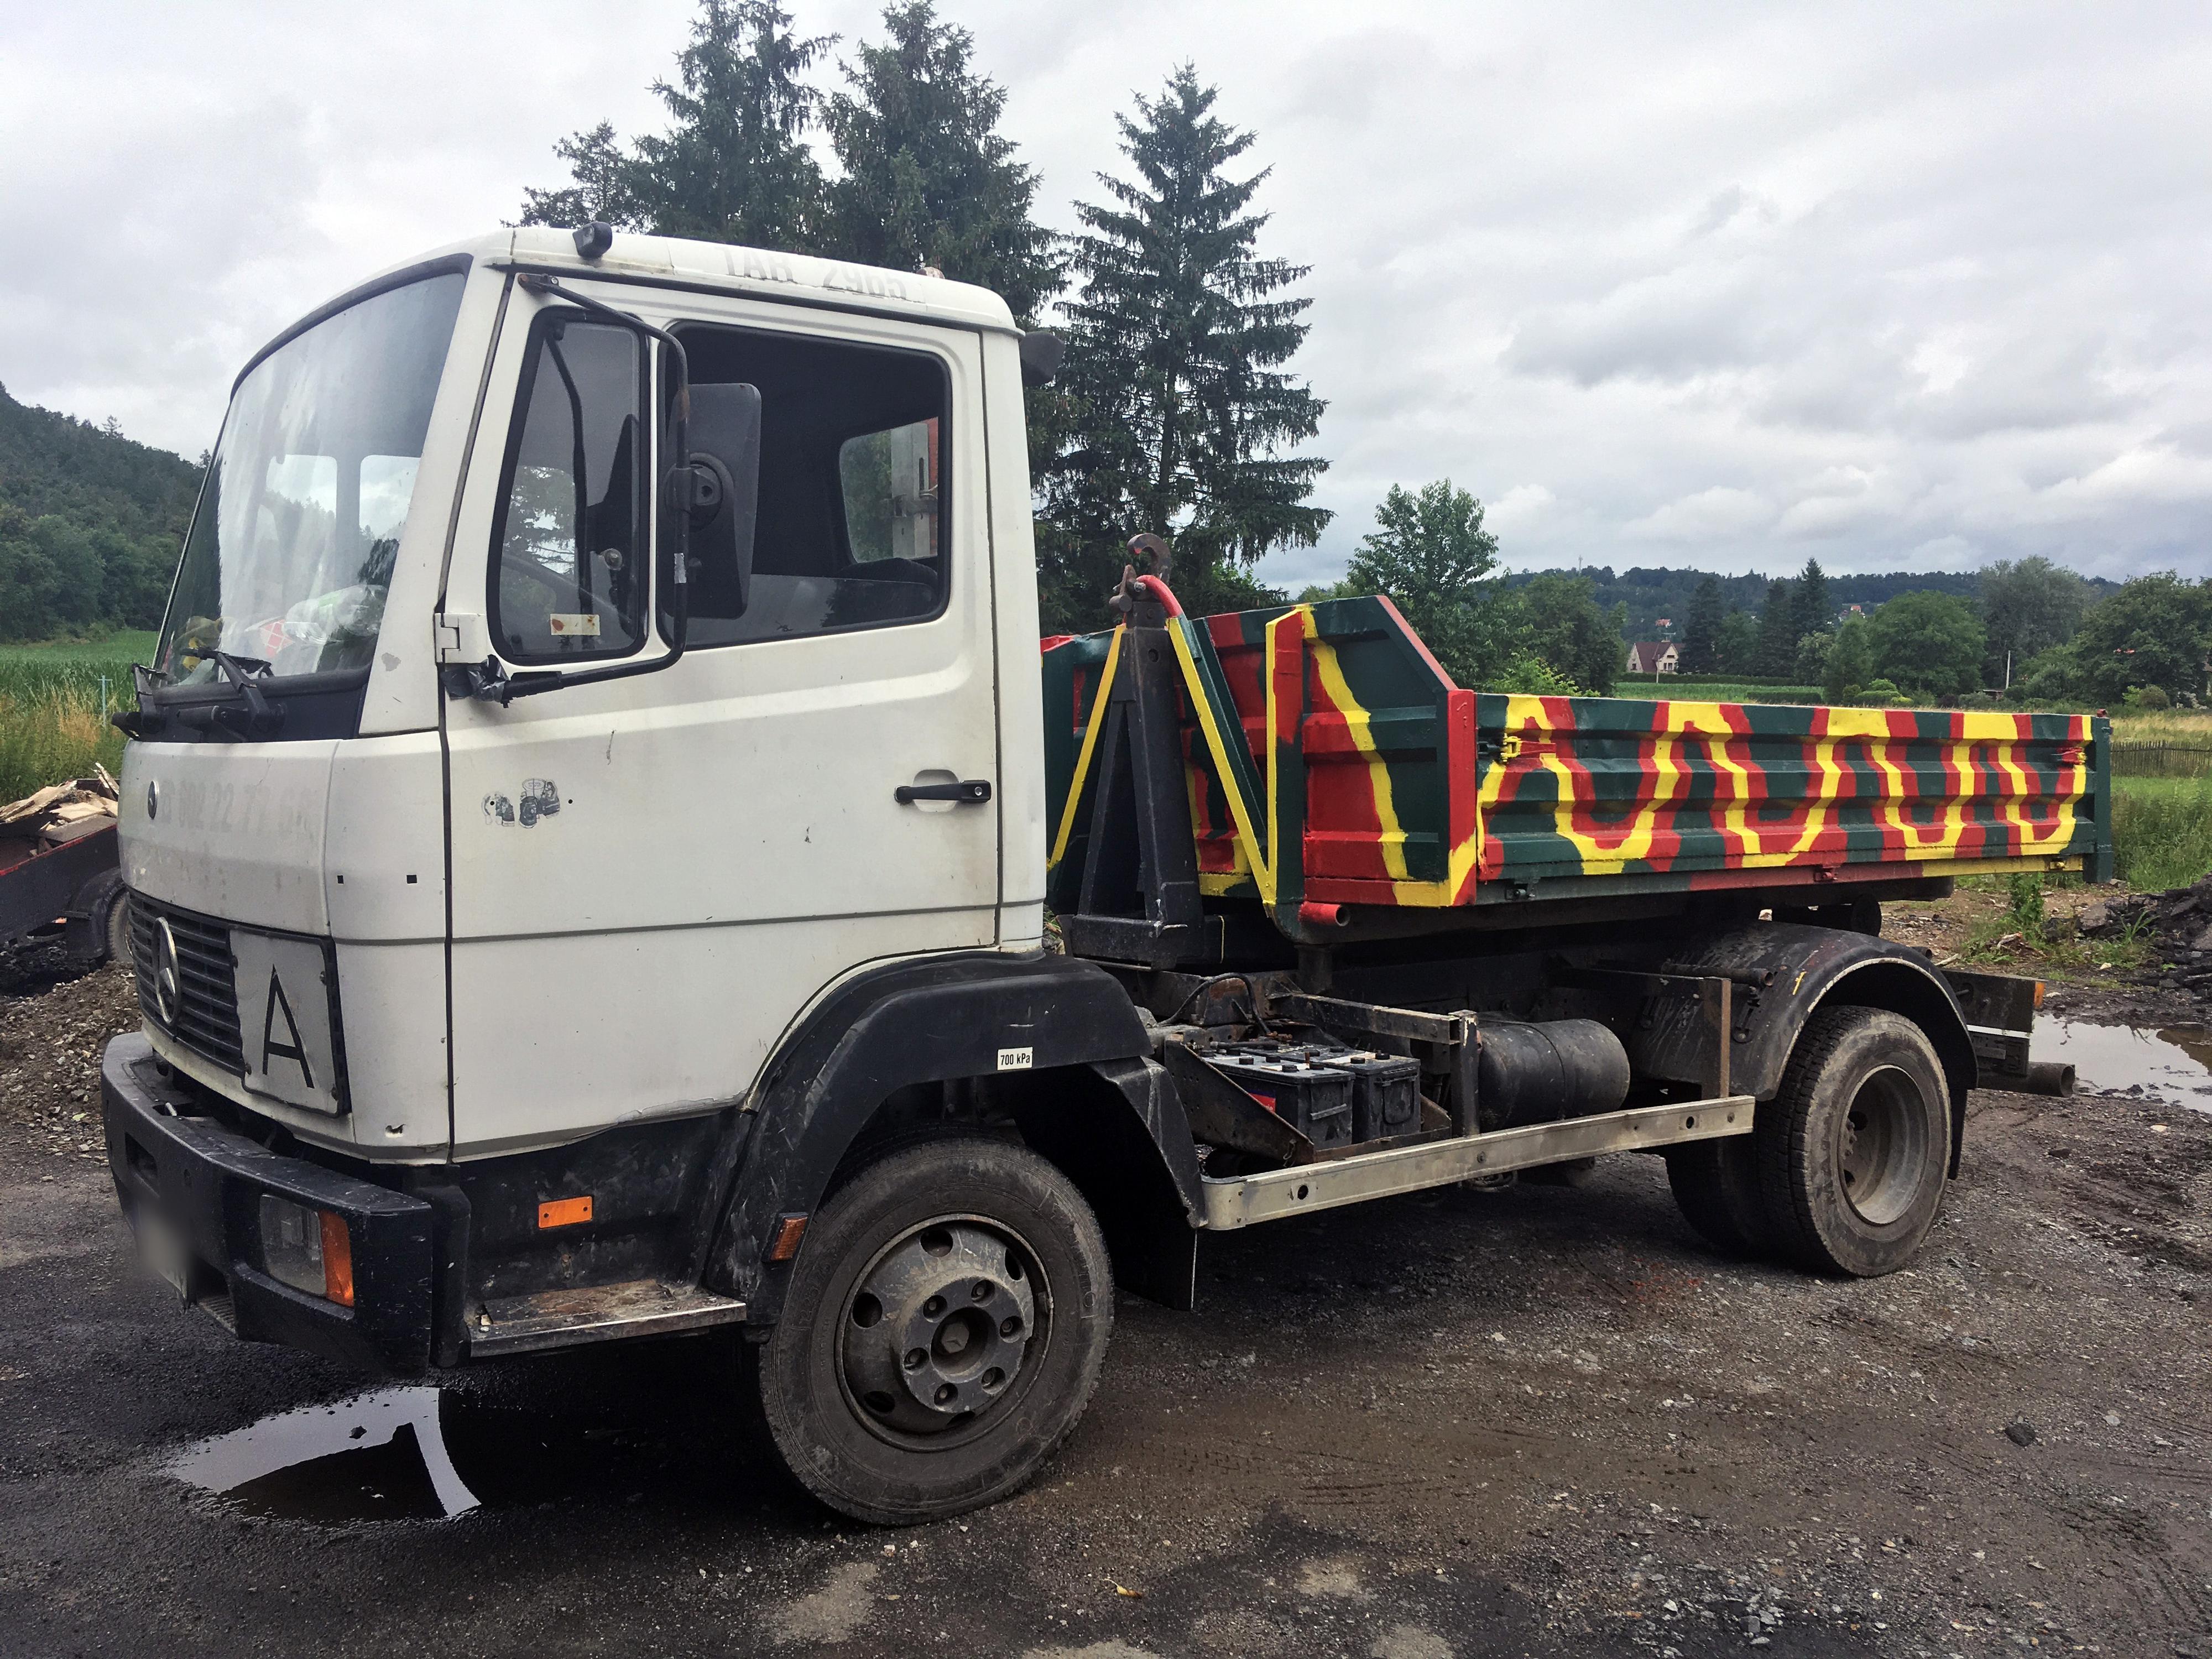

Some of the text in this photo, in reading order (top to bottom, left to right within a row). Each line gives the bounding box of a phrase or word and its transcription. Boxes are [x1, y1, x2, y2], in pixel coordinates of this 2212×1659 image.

[262, 963, 315, 1089] A
[1000, 1053, 1030, 1066] 700 kPa
